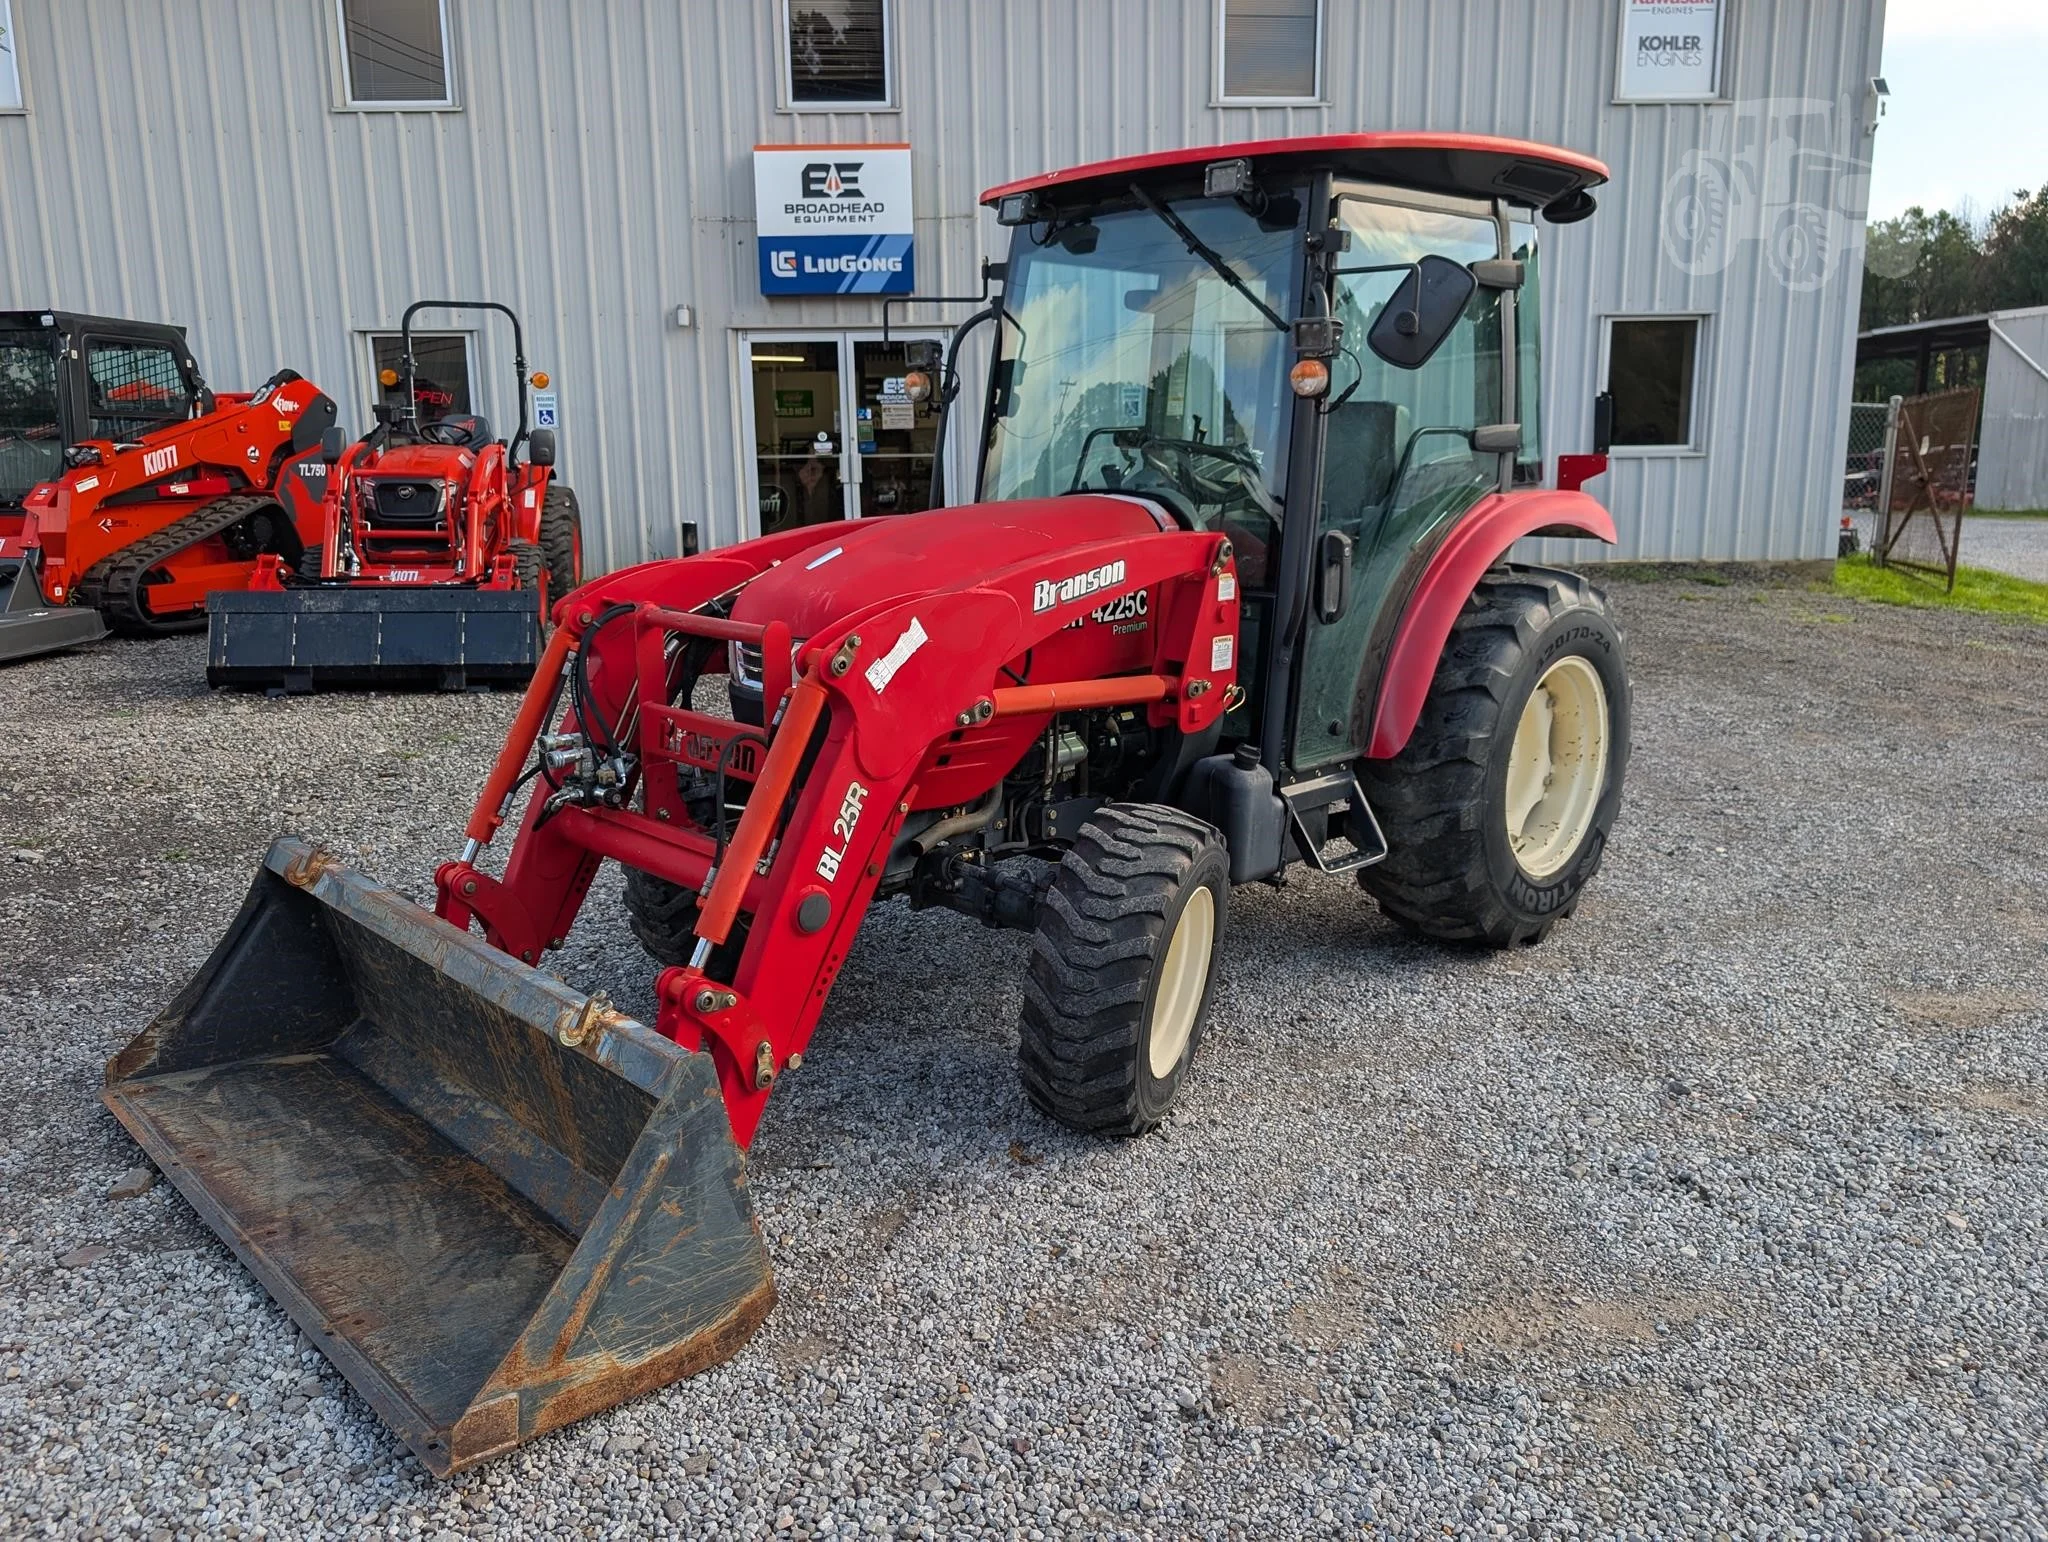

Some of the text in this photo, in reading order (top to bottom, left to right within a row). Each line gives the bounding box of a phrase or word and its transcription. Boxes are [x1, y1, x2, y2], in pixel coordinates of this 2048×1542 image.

[1651, 6, 1694, 15] ENGINES
[1638, 35, 1702, 51] KOHLER
[1636, 51, 1702, 67] ENGINES
[784, 202, 885, 214] BROADHEAD
[794, 214, 876, 224] EQUIPMENT
[143, 444, 178, 477] KIOTI
[298, 463, 326, 477] TL750
[390, 570, 419, 582] KIOTI
[1033, 559, 1125, 613] Branson
[1091, 589, 1148, 623] 4225C
[1112, 620, 1148, 636] Premium
[1511, 876, 1575, 914] TIRON
